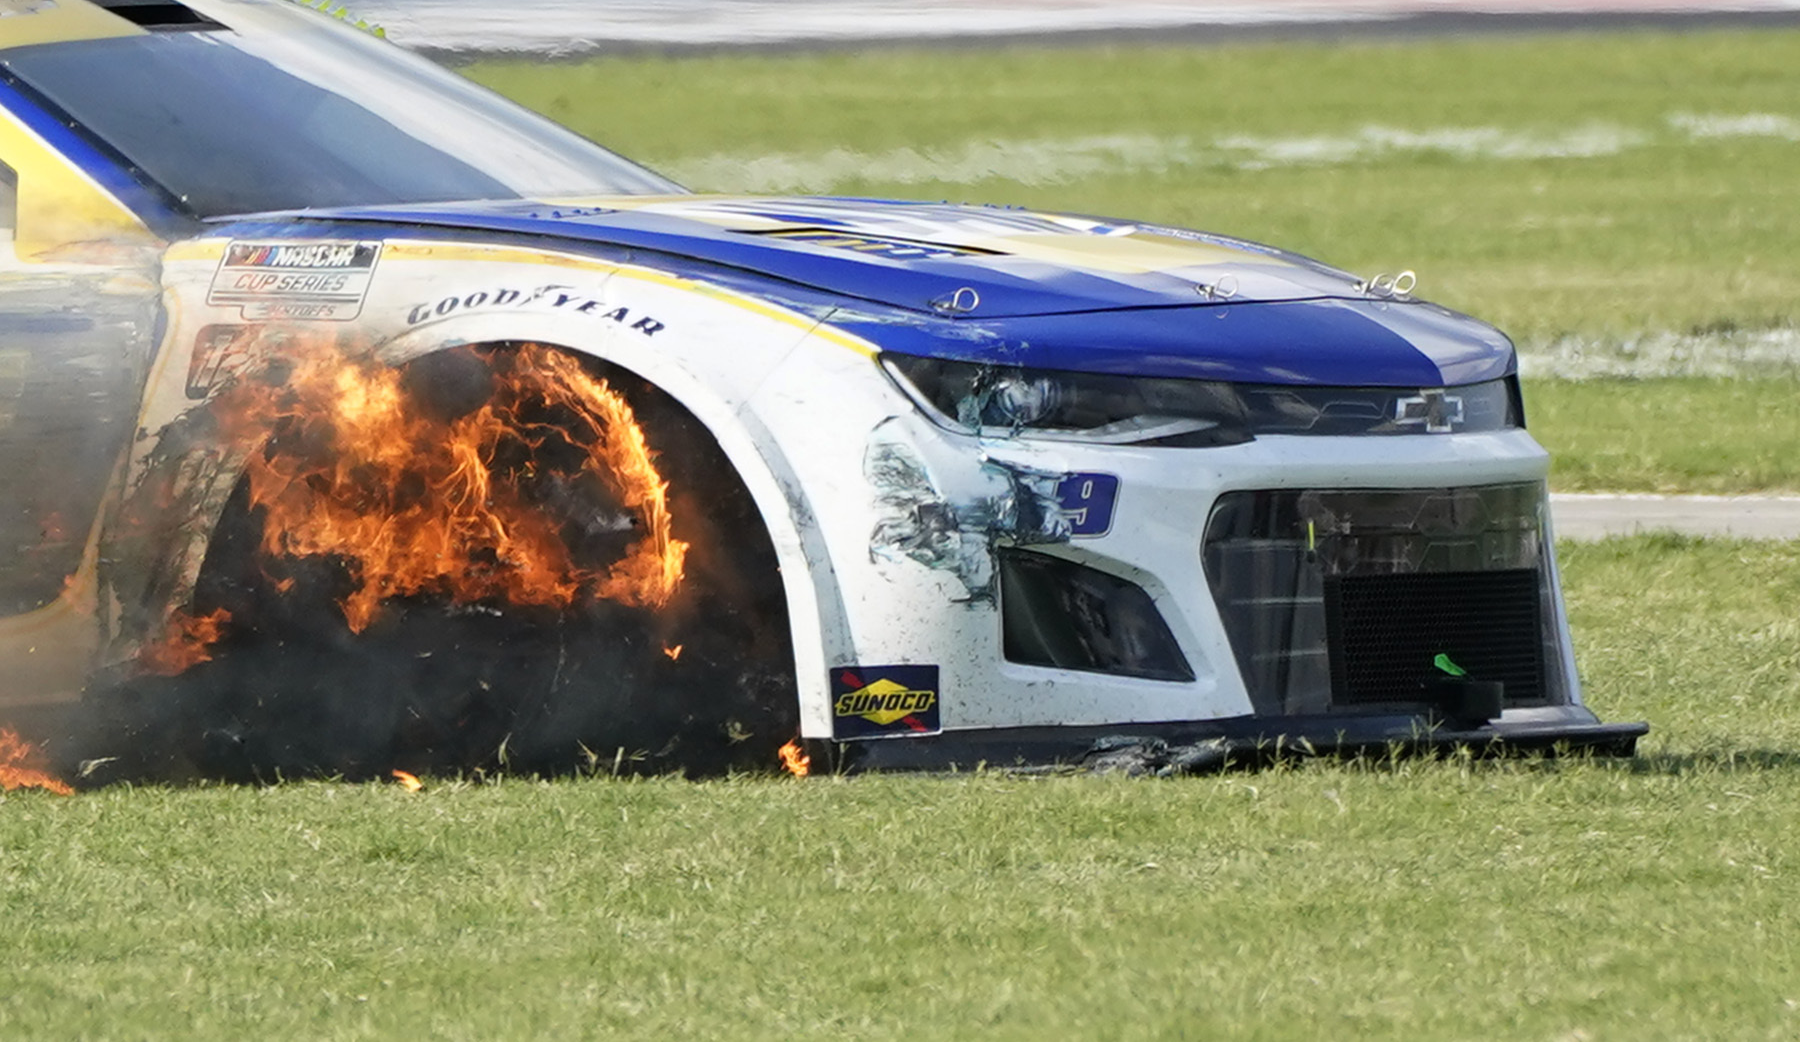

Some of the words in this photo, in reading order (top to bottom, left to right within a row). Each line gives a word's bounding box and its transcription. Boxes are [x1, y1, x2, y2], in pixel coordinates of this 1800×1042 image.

[272, 244, 356, 267] NASCAR
[233, 273, 277, 290] CUP
[276, 274, 349, 292] SERIES
[407, 283, 667, 338] GOODYEAR
[838, 692, 932, 715] SUNOCO
